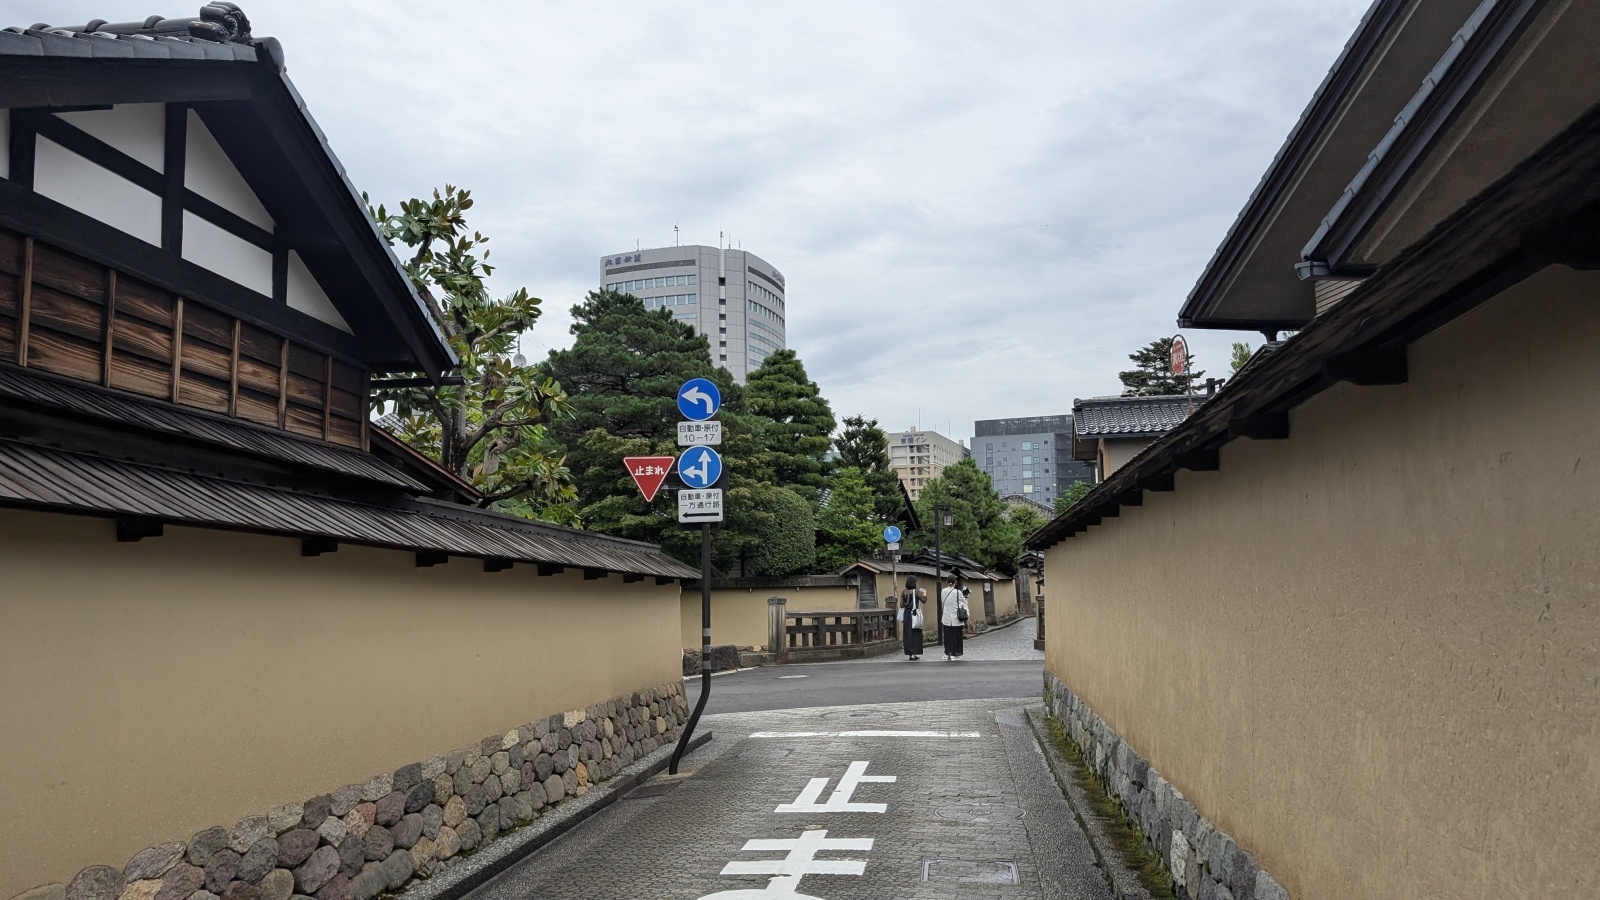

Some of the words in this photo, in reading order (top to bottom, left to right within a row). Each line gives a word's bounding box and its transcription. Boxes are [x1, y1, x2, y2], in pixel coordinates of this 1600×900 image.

[635, 465, 664, 475] 止まれ
[680, 501, 720, 509] 一方通行路
